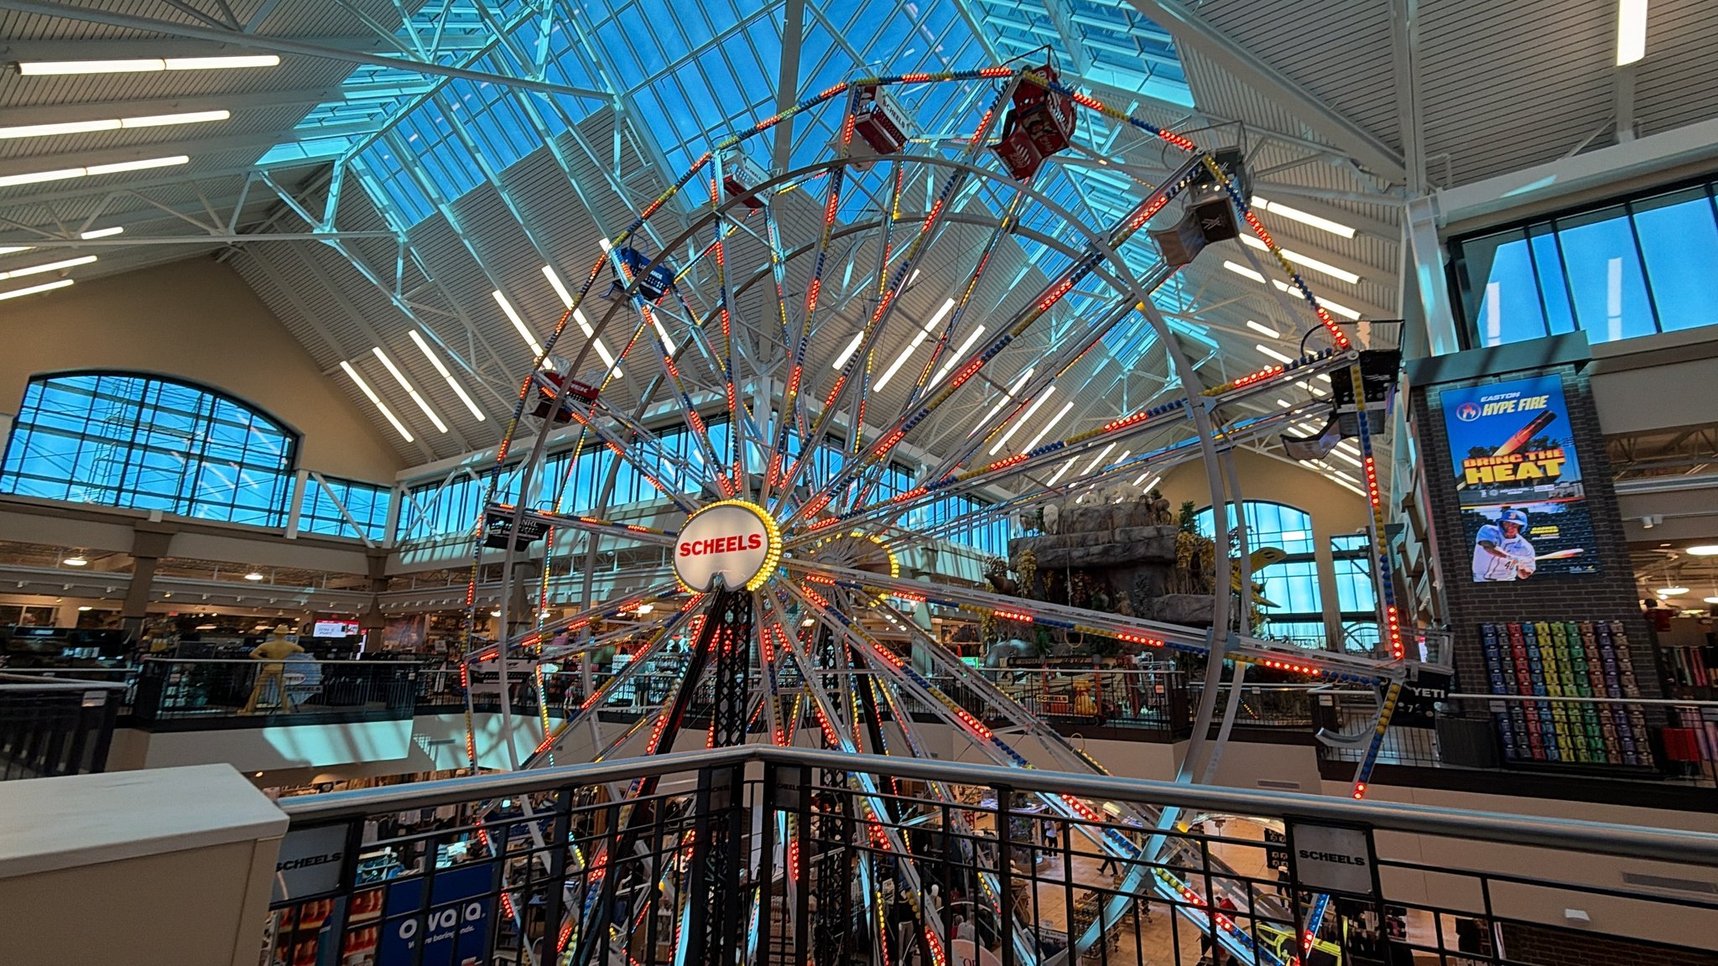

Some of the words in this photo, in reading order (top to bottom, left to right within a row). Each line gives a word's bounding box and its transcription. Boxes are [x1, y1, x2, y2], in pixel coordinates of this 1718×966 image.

[882, 98, 906, 129] SCHEELS
[1480, 392, 1521, 402] EASTON
[1482, 400, 1516, 416] HYPE
[1518, 395, 1550, 411] FIRE
[1463, 454, 1524, 468] BRING
[1524, 447, 1566, 461] THE
[1465, 457, 1567, 485] HEAT
[680, 533, 762, 557] SCHEELS
[1412, 687, 1445, 699] YETI
[1299, 849, 1366, 866] SCHEELS
